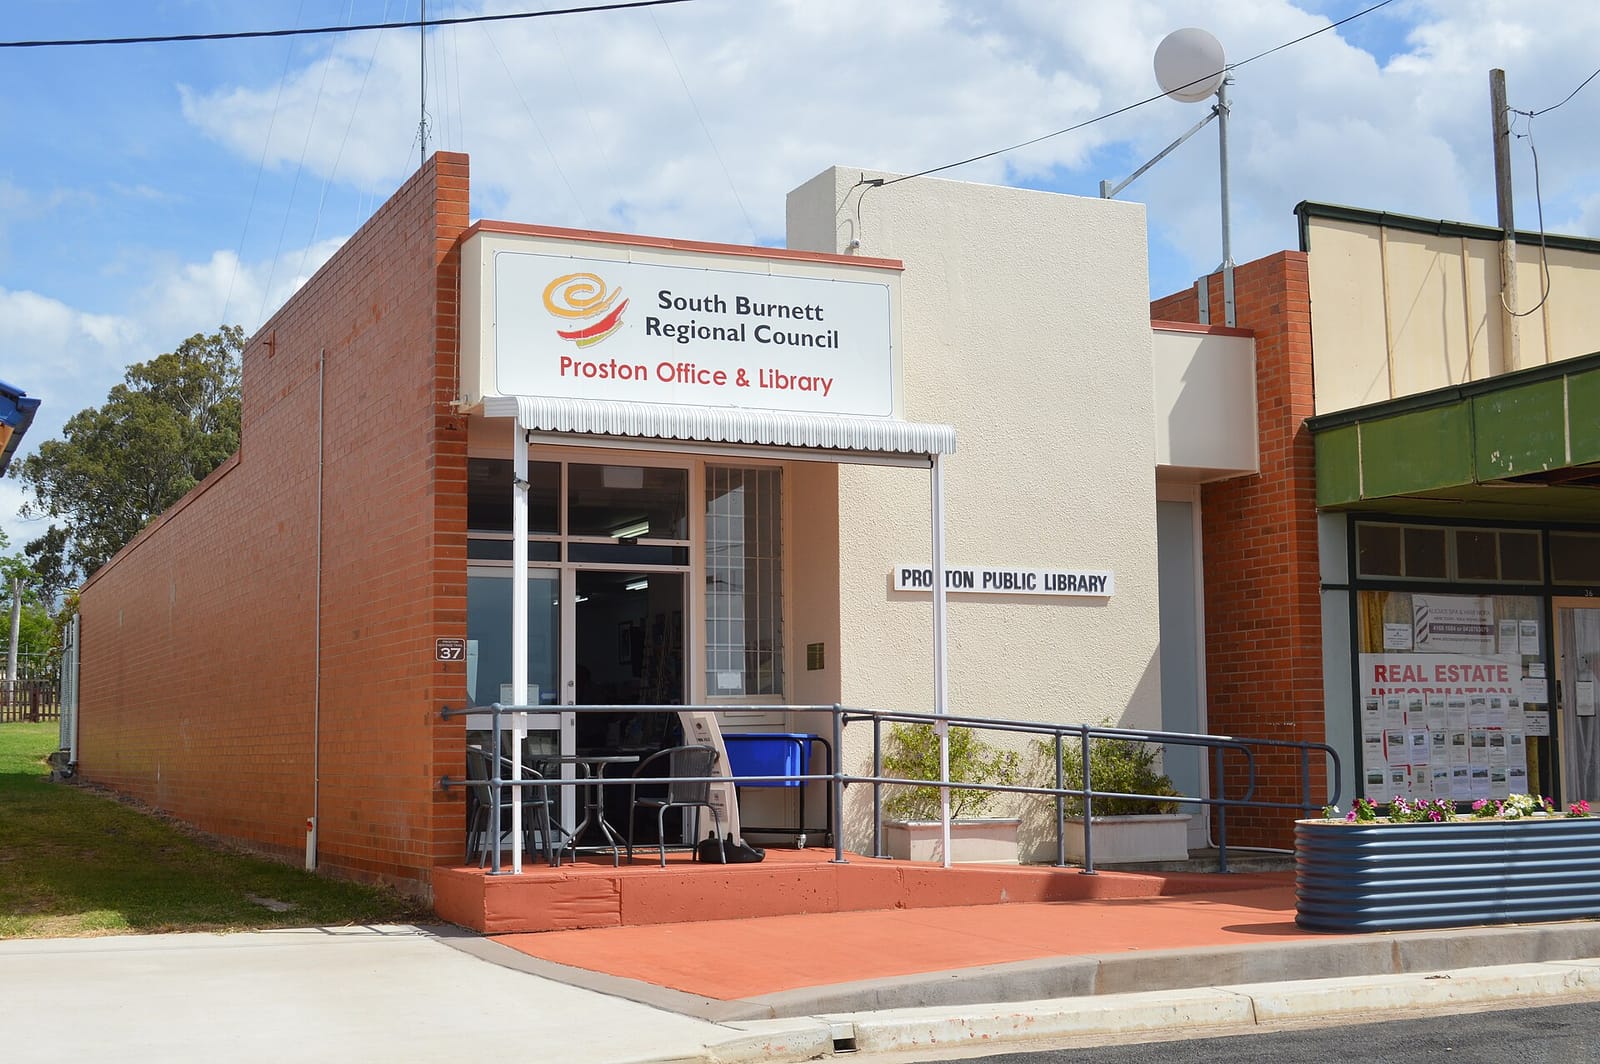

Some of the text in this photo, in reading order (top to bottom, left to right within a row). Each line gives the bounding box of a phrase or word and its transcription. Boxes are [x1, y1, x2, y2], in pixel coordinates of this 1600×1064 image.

[659, 290, 824, 321] South Burnett
[646, 317, 839, 349] Regional Council
[560, 356, 833, 396] Proston Office & Library
[902, 569, 1108, 592] PROTON PUBLIC LIBRARY
[441, 648, 460, 659] 37
[1374, 664, 1428, 682] REAL
[1435, 664, 1509, 682] ESTATE
